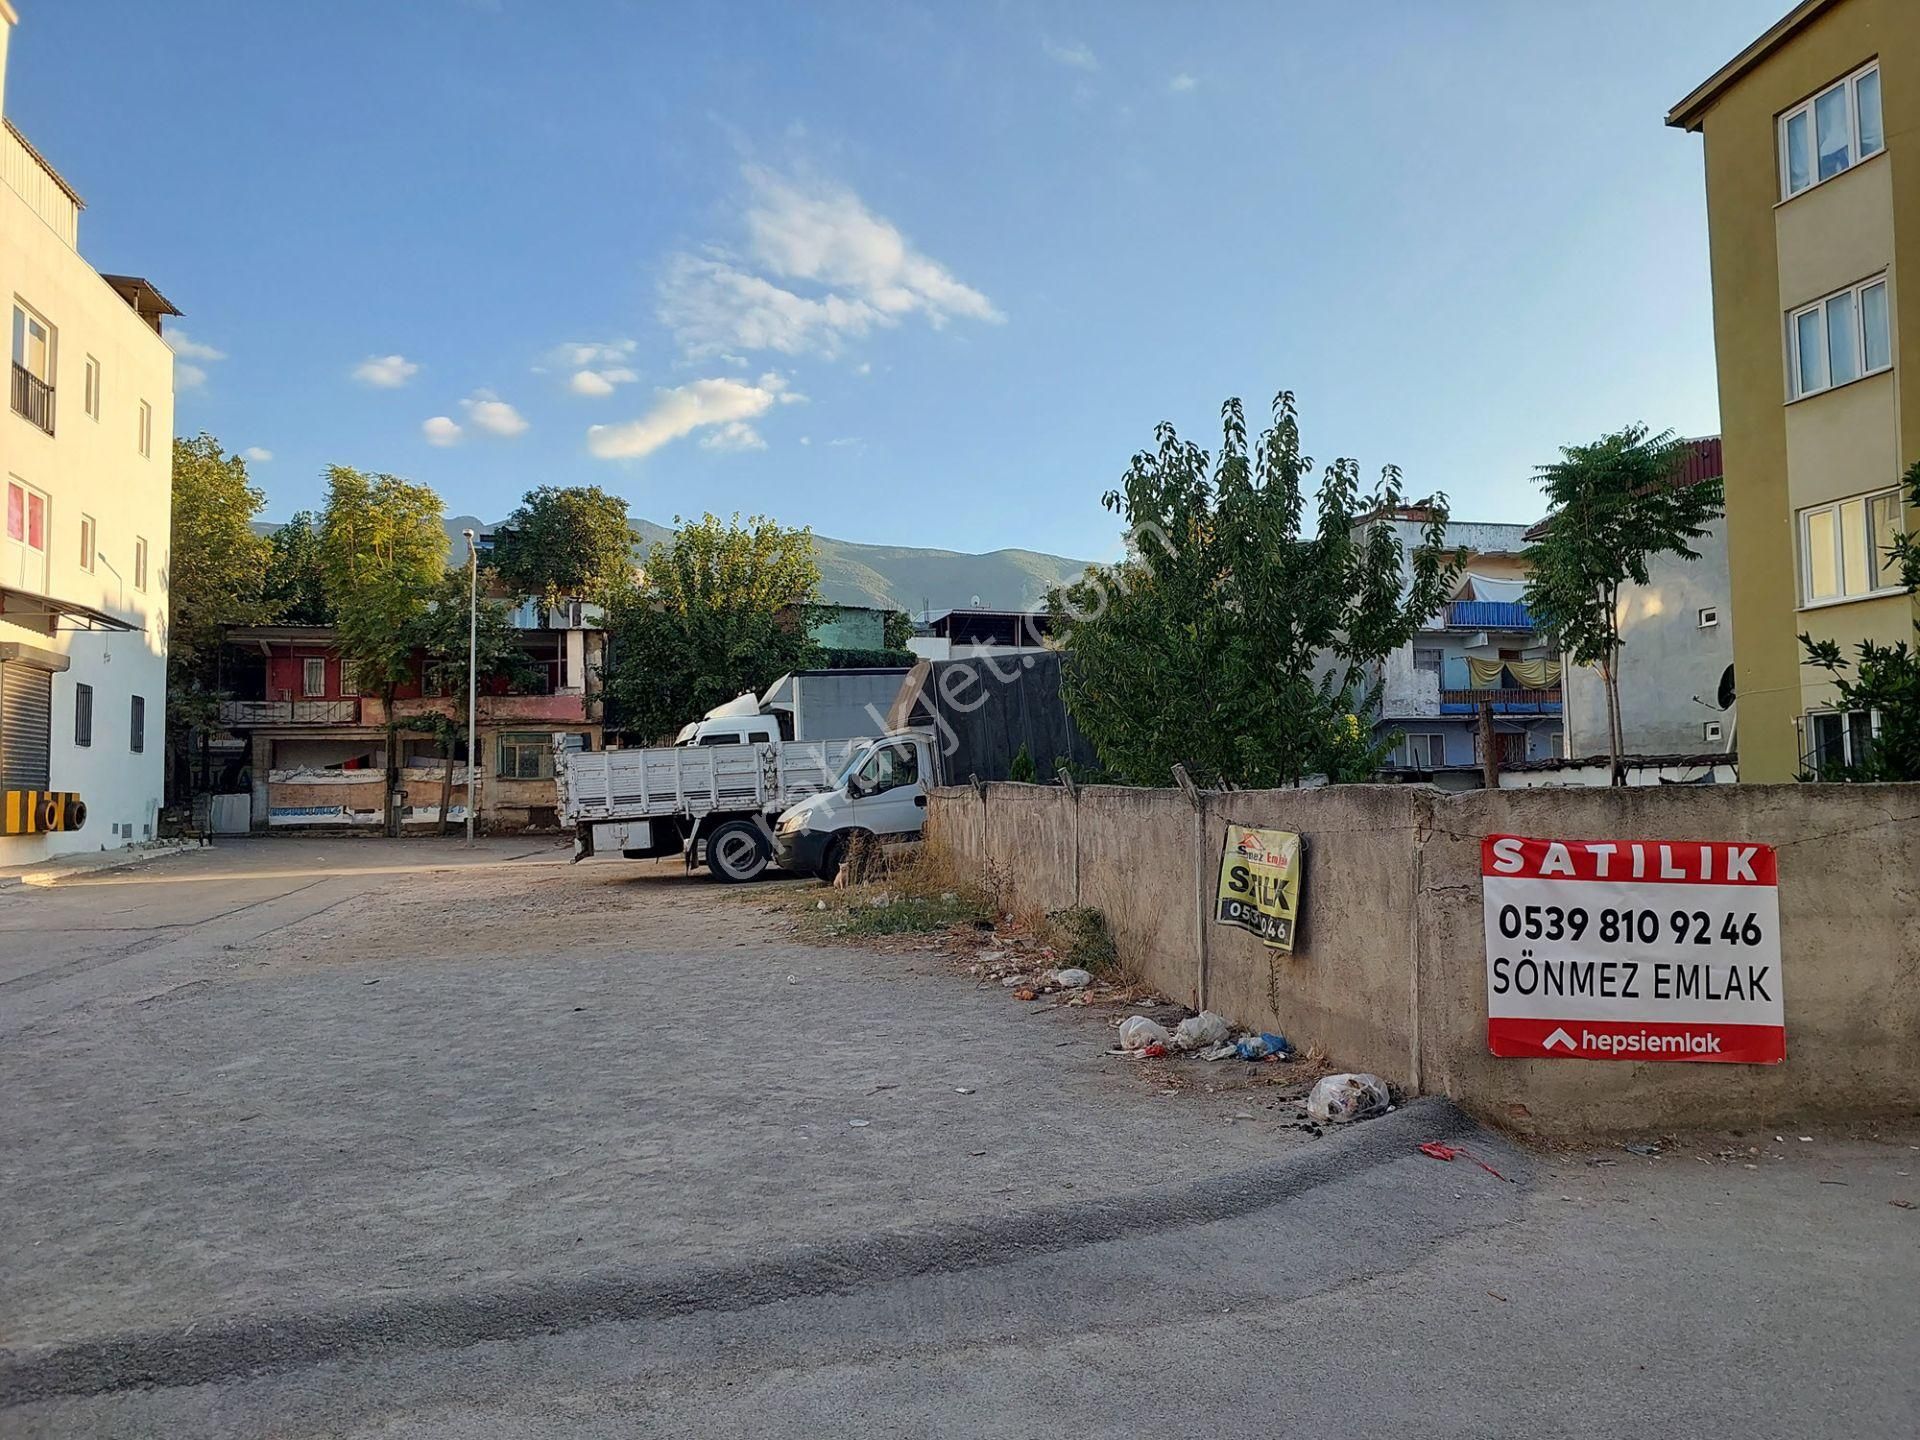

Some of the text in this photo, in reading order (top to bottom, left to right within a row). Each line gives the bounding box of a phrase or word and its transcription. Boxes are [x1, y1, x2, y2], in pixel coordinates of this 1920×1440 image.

[1492, 837, 1759, 881] SATILIK
[1499, 904, 1762, 946] 0539 810 92 46
[1493, 949, 1772, 1001] SÖNMEZ EMLAK
[1582, 1030, 1721, 1054] hepsiemlak
